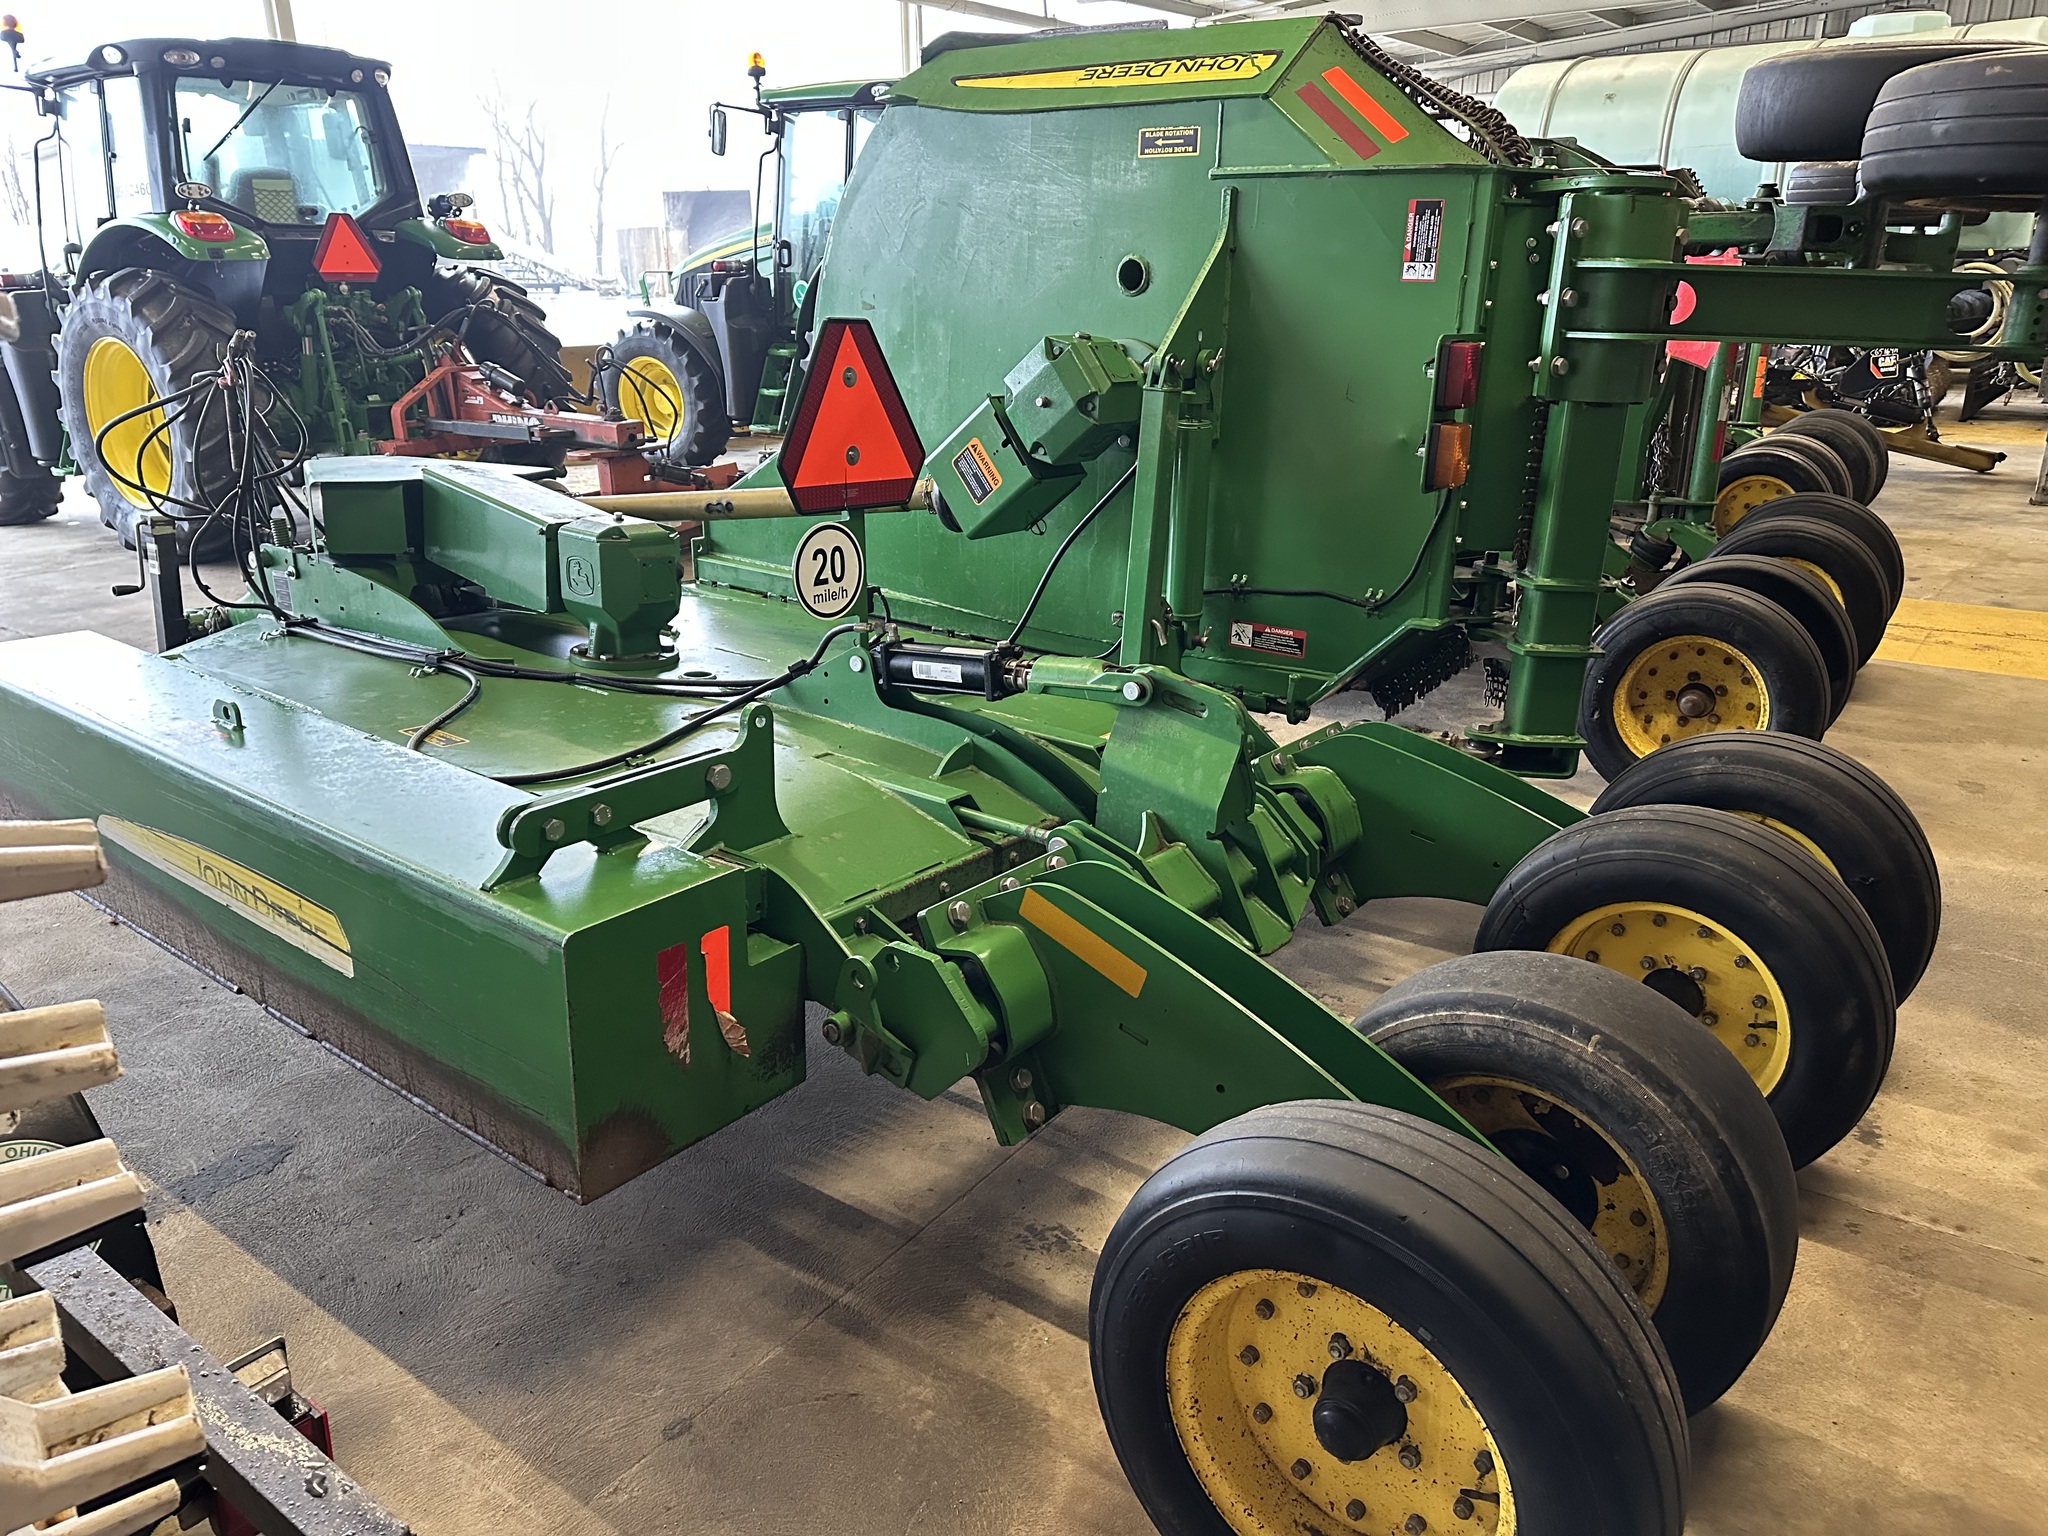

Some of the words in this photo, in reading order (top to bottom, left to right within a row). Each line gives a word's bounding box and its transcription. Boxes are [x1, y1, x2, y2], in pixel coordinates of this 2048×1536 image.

[1077, 62, 1173, 81] DEERE
[1175, 55, 1258, 74] JOHN
[1145, 130, 1164, 138] BLADE
[1164, 129, 1194, 137] ROTATION
[1405, 212, 1415, 242] DANGER
[1878, 356, 1897, 367] CAT
[976, 449, 1000, 486] WARNING
[812, 545, 846, 587] 20
[812, 586, 849, 605] mile/h
[1270, 627, 1294, 636] DANGER
